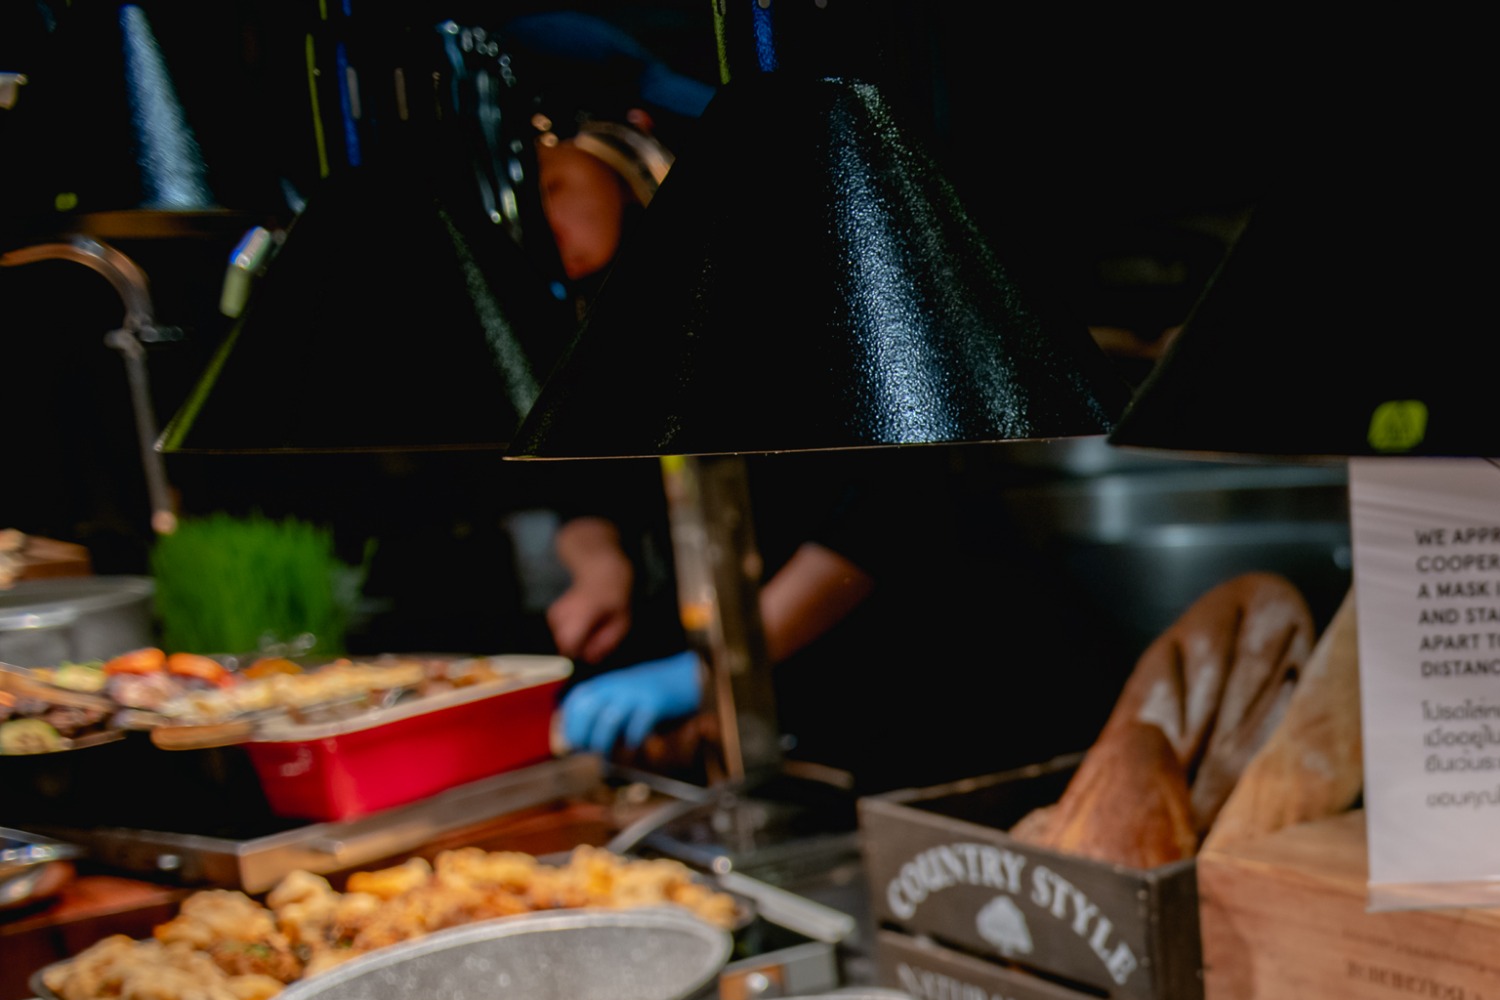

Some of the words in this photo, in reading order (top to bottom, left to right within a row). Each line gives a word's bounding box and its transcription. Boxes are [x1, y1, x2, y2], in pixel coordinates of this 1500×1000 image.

[1416, 528, 1445, 546] WE
[1418, 584, 1431, 599] A
[1437, 580, 1491, 598] MASK
[1419, 607, 1459, 624] AND
[1420, 633, 1479, 651] APART
[887, 842, 1028, 920] COUNTRY
[1030, 865, 1138, 986] STYLE
